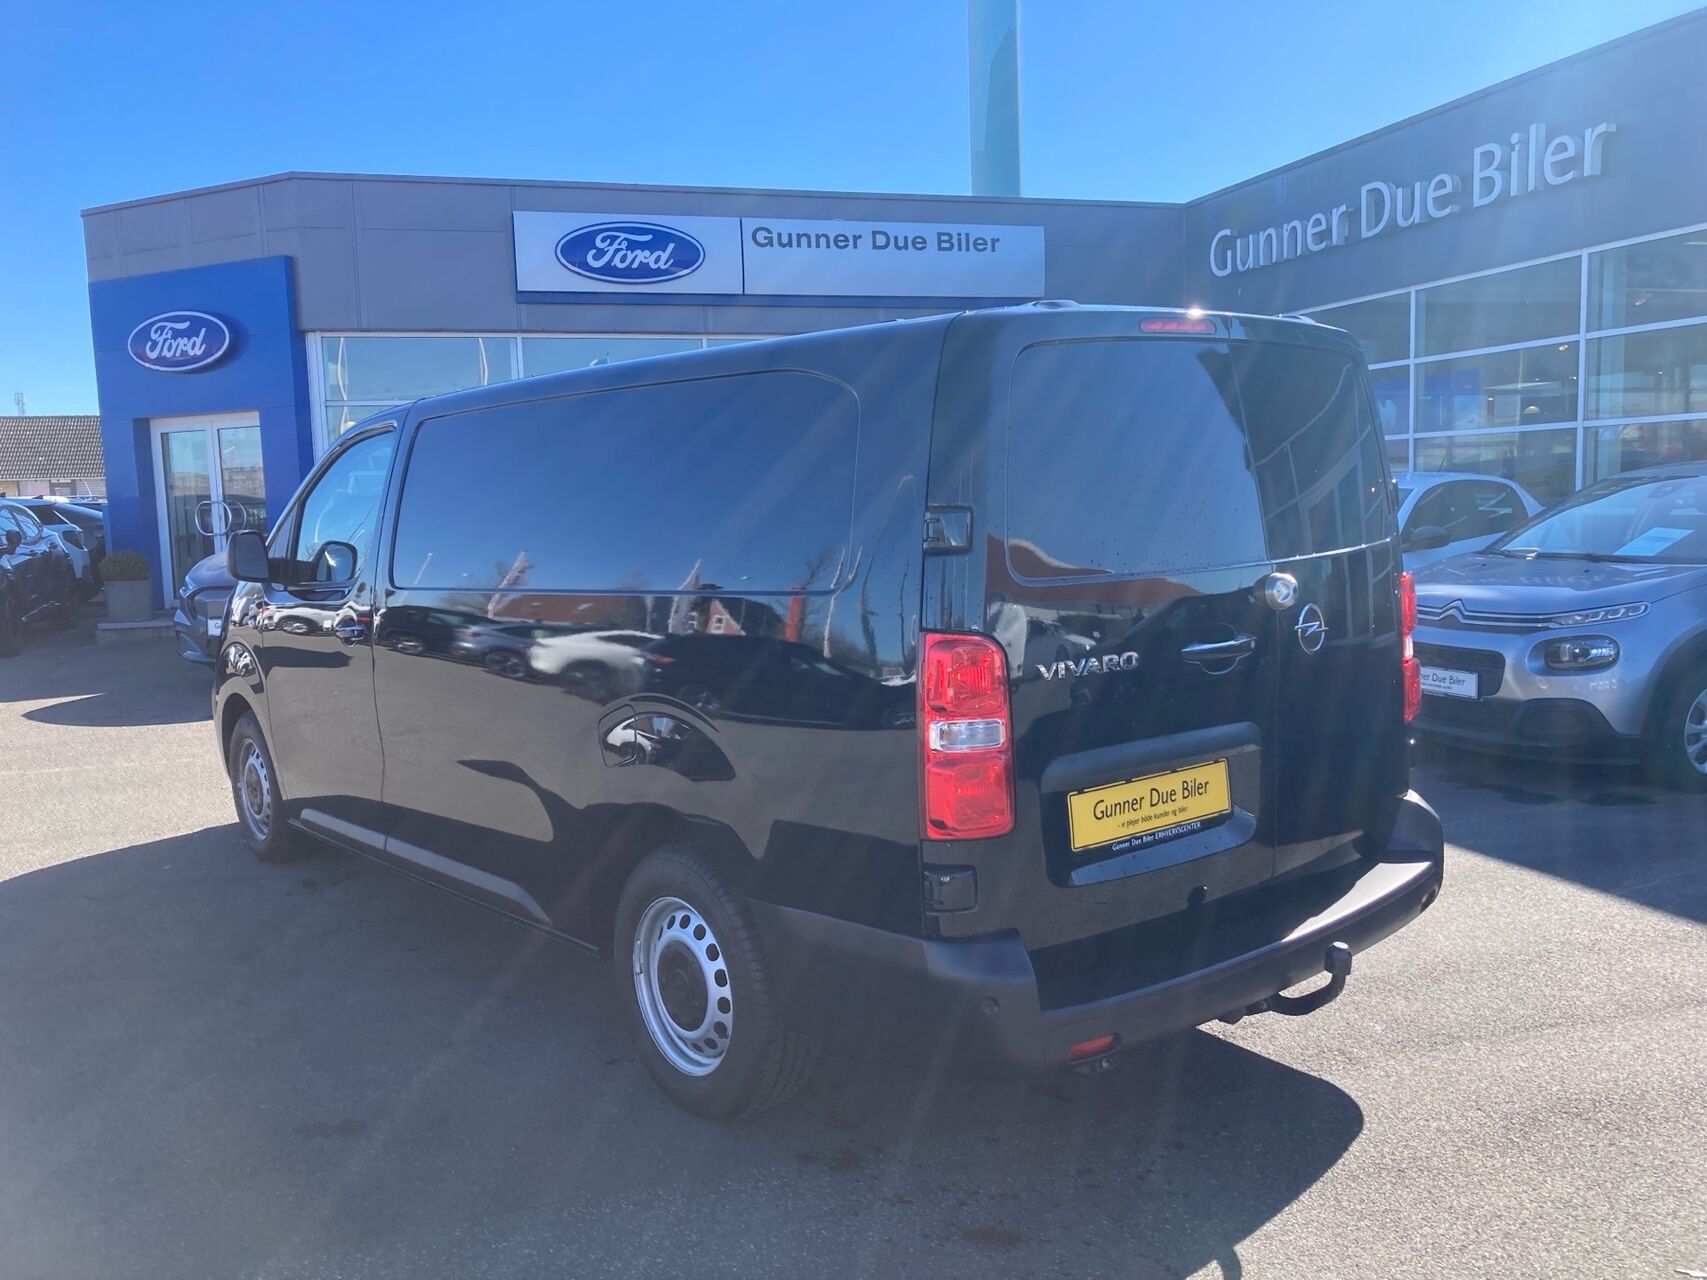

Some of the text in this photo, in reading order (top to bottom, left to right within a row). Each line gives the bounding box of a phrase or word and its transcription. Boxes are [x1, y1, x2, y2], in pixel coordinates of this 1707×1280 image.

[1210, 122, 1616, 277] Gunner Due Biler
[586, 231, 674, 269] Ford
[751, 226, 1000, 253] Gunner Due Biler
[145, 320, 206, 359] Ford
[1035, 651, 1139, 680] VIVARO
[1432, 672, 1447, 683] Due
[1449, 674, 1466, 686] Biler
[1093, 777, 1209, 821] Gunner Due Biler
[1112, 841, 1130, 851] Gunner
[1131, 838, 1142, 846] Due
[1142, 834, 1155, 843] Biler
